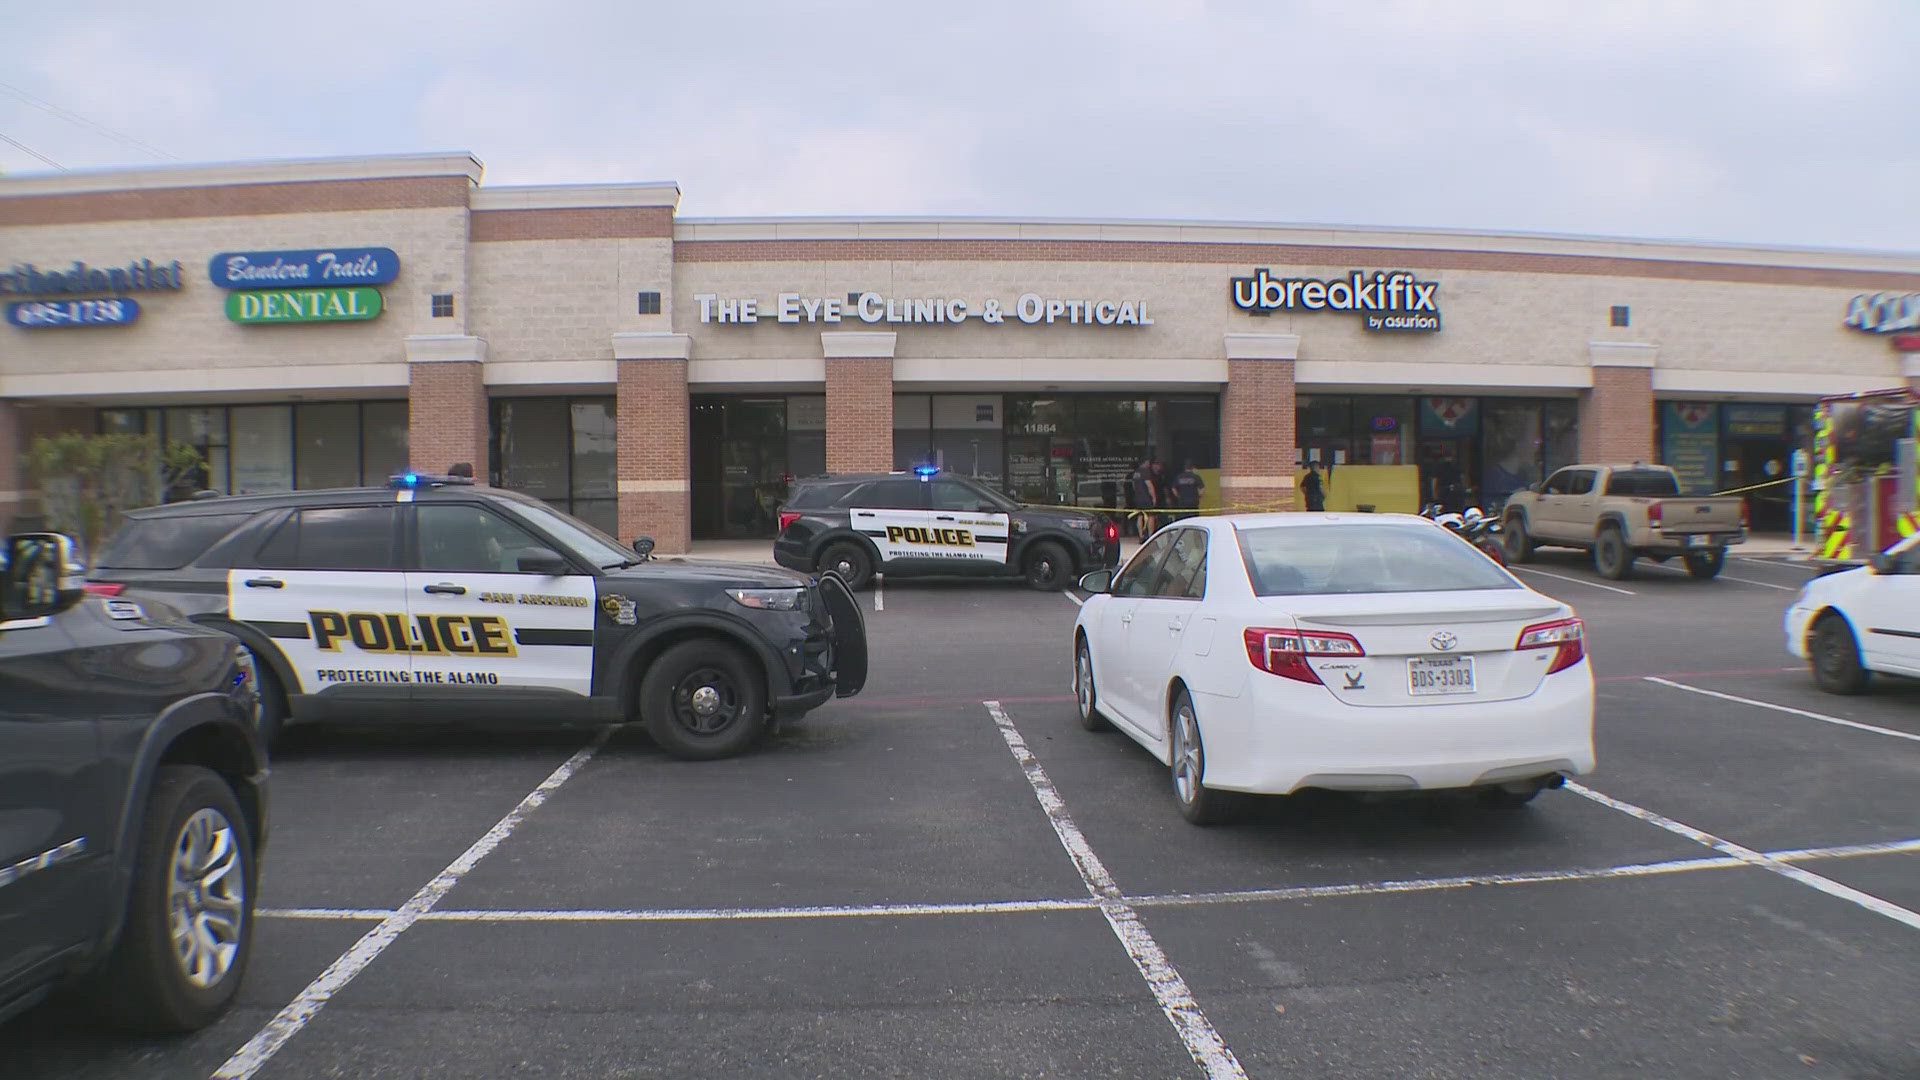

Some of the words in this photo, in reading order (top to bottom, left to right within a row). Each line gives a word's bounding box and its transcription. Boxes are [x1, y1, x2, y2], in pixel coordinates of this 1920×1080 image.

[226, 254, 310, 282] Bandera
[316, 252, 380, 279] Trails
[1234, 271, 1438, 312] ubreakifix
[239, 290, 368, 319] DENTAL
[694, 293, 758, 324] THE
[777, 293, 842, 324] EYE
[857, 292, 967, 324] CLINIC
[983, 298, 1005, 324] &
[1016, 292, 1155, 326] OPTICAL
[1369, 315, 1384, 330] by
[1385, 314, 1438, 329] asurion
[1024, 424, 1057, 433] 11864
[886, 526, 975, 547] POLICE
[480, 592, 515, 603] SAN
[519, 593, 589, 608] ANTONIO
[308, 610, 518, 657] POLICE
[317, 668, 410, 683] PROTECTING
[413, 670, 444, 684] THE
[448, 671, 498, 685] ALAMO
